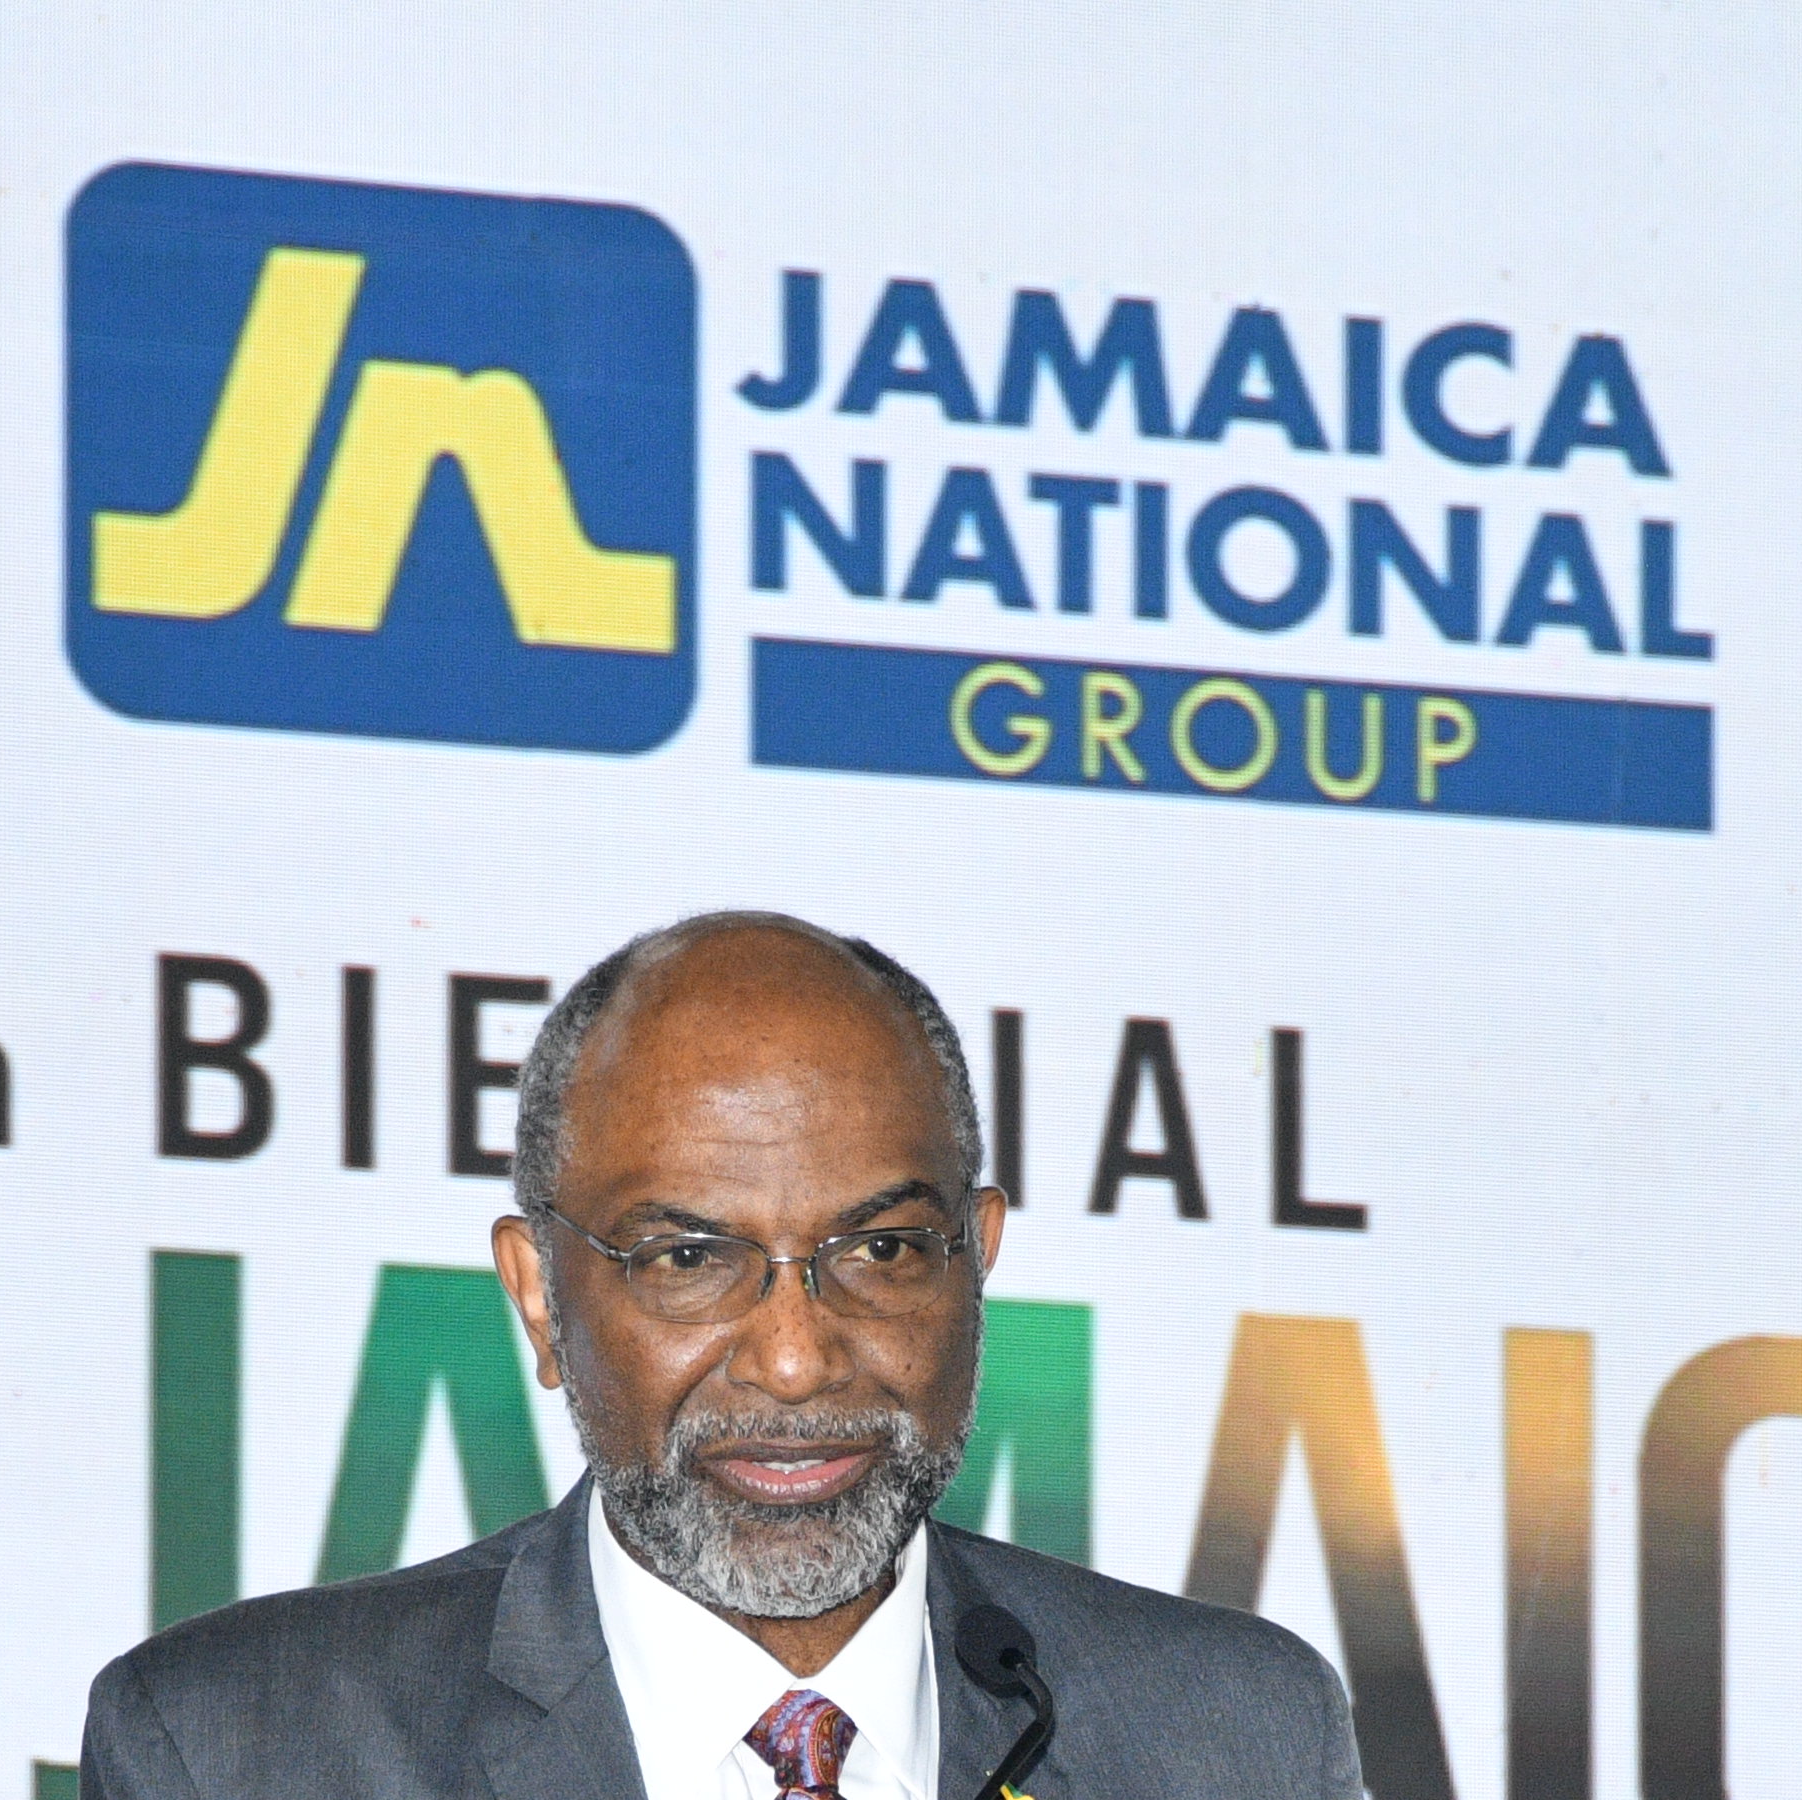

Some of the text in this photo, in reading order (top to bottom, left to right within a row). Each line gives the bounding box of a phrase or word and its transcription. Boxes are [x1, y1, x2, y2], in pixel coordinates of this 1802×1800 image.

[736, 270, 1671, 479] JAMAICA
[750, 451, 1714, 661] NATIONAL
[950, 662, 1479, 803] GROUP
[156, 951, 1368, 1232] BIEIAL
